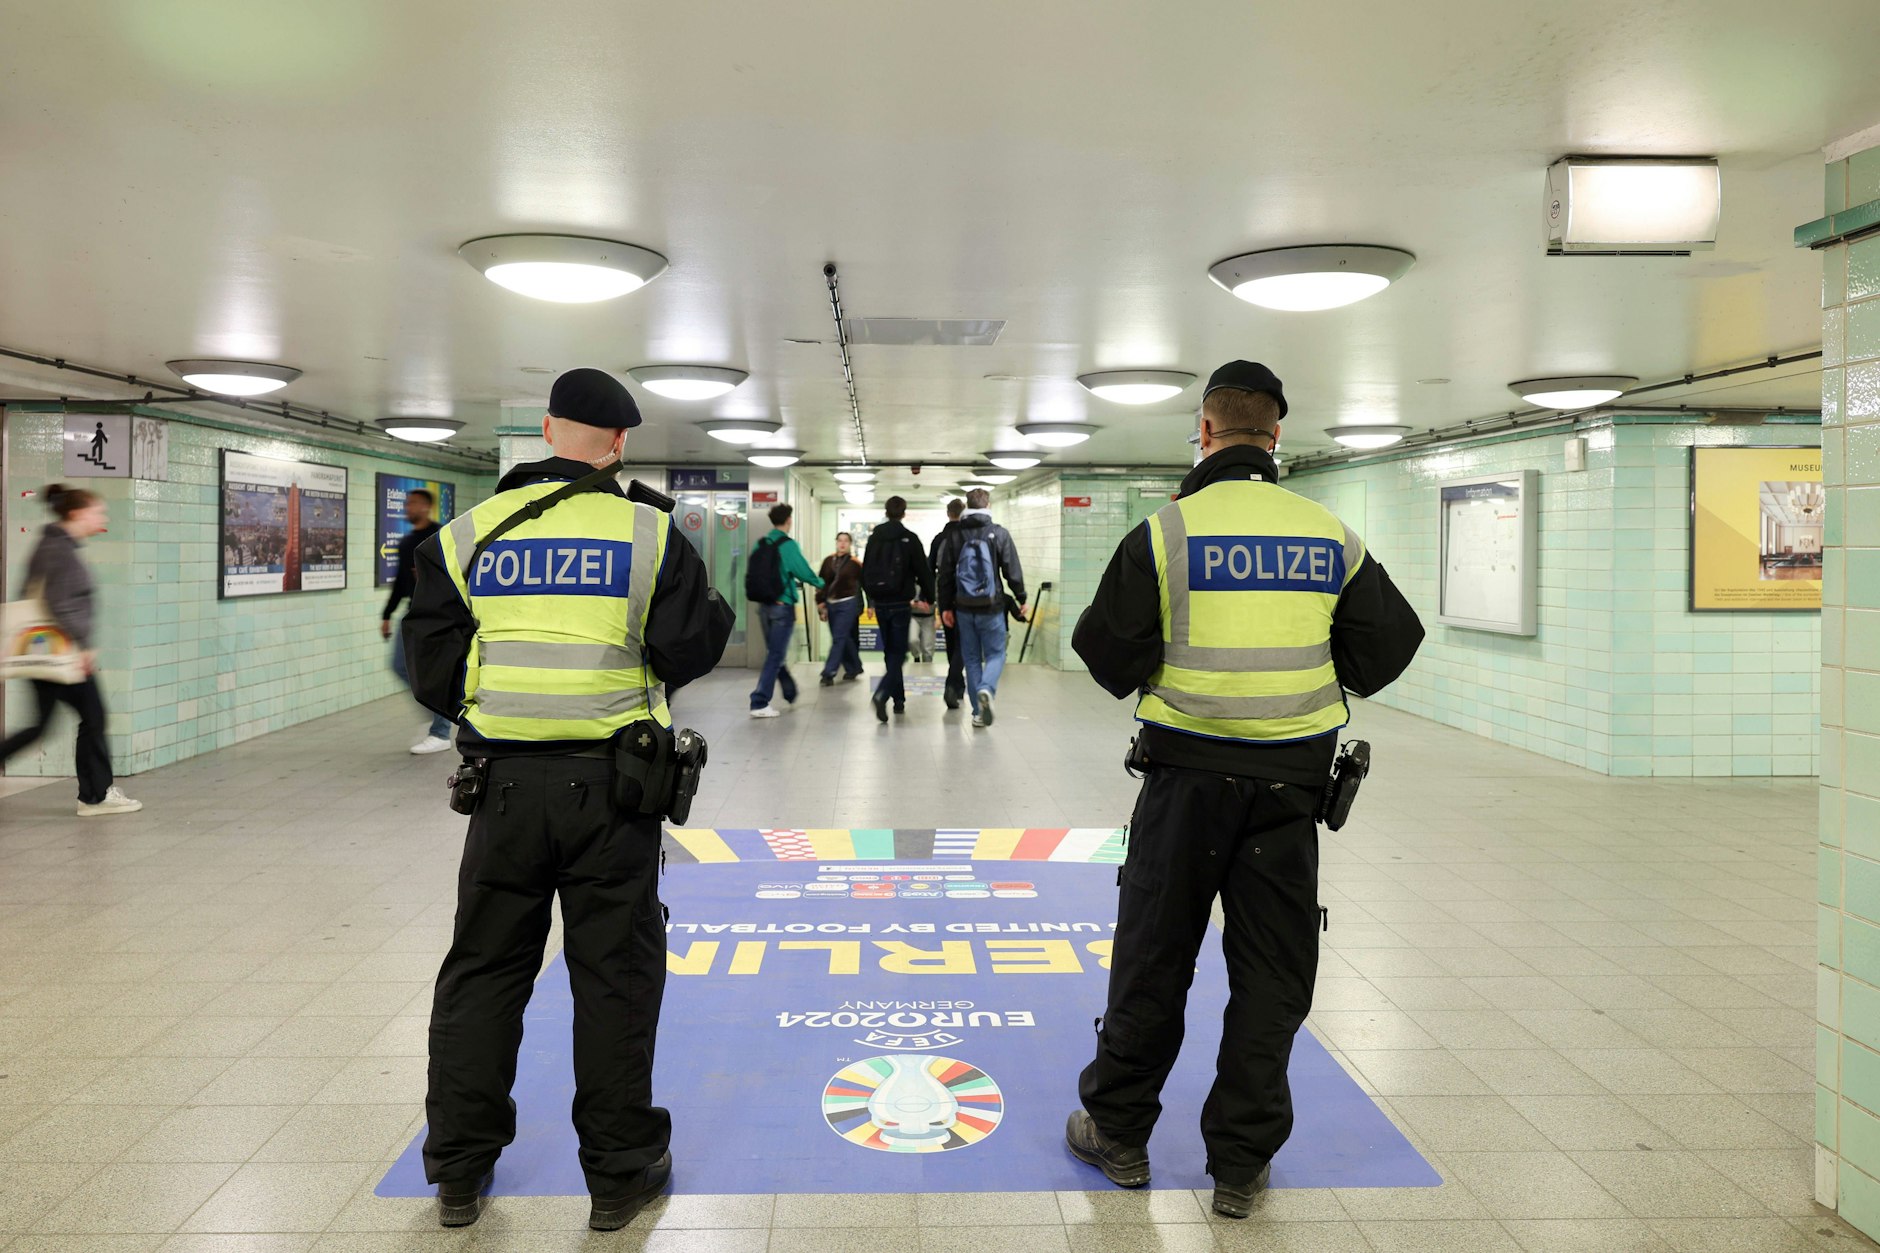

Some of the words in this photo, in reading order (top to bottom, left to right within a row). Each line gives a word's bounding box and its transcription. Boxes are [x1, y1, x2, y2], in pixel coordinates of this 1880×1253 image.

[723, 471, 731, 481] S
[1465, 487, 1493, 498] Information
[475, 549, 613, 587] POLIZEI
[1204, 545, 1335, 583] POLIZEI
[880, 923, 936, 933] BY
[945, 922, 1102, 933] UNITED
[838, 1000, 975, 1010] GERMANY
[776, 1011, 1036, 1028] EURO2024
[865, 1031, 958, 1048] UEFA
